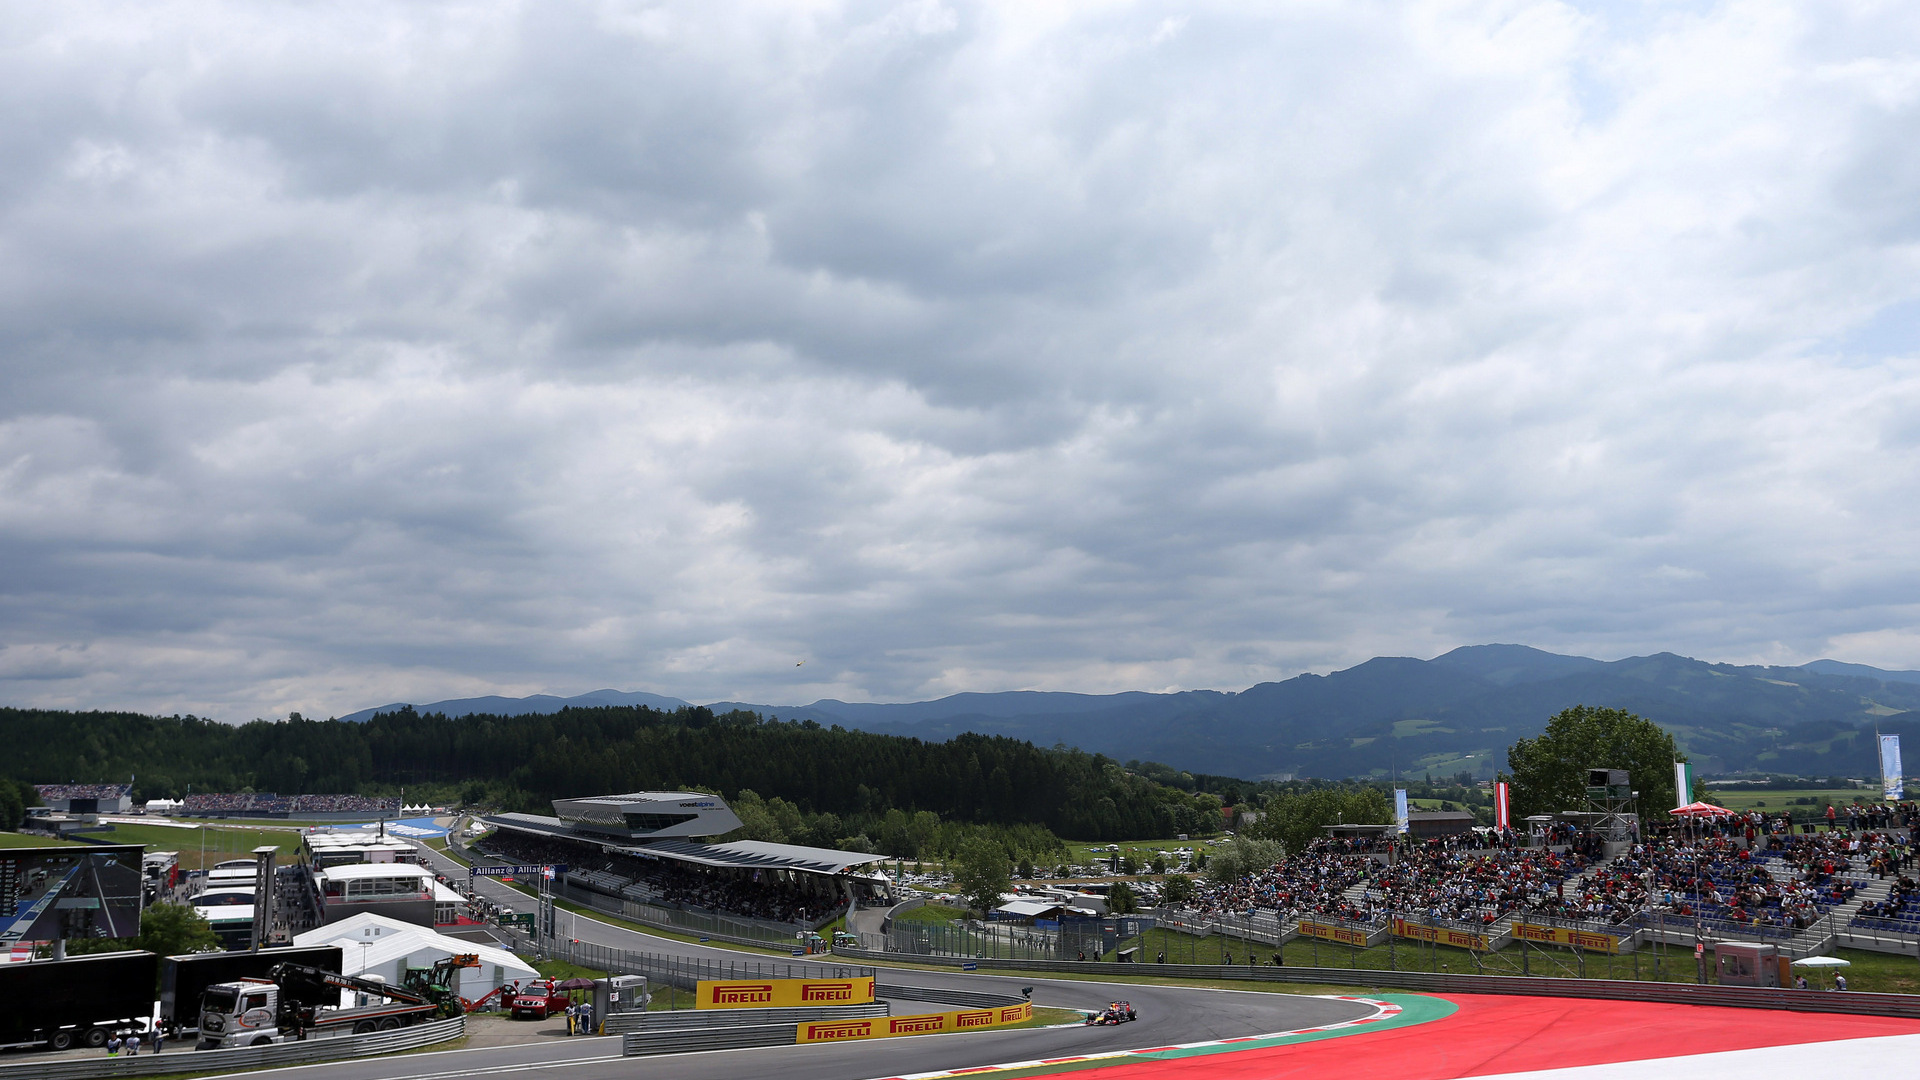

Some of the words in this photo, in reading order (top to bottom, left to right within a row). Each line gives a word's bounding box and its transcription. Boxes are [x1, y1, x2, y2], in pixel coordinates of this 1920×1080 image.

[713, 985, 773, 1003] PIRELLI
[802, 983, 853, 1000] PIRELLI
[808, 1022, 871, 1039] PIRELLI
[890, 1016, 944, 1033] PIRELLI
[957, 1011, 993, 1027] PIRELLI
[1001, 1007, 1022, 1022] PIRELLI
